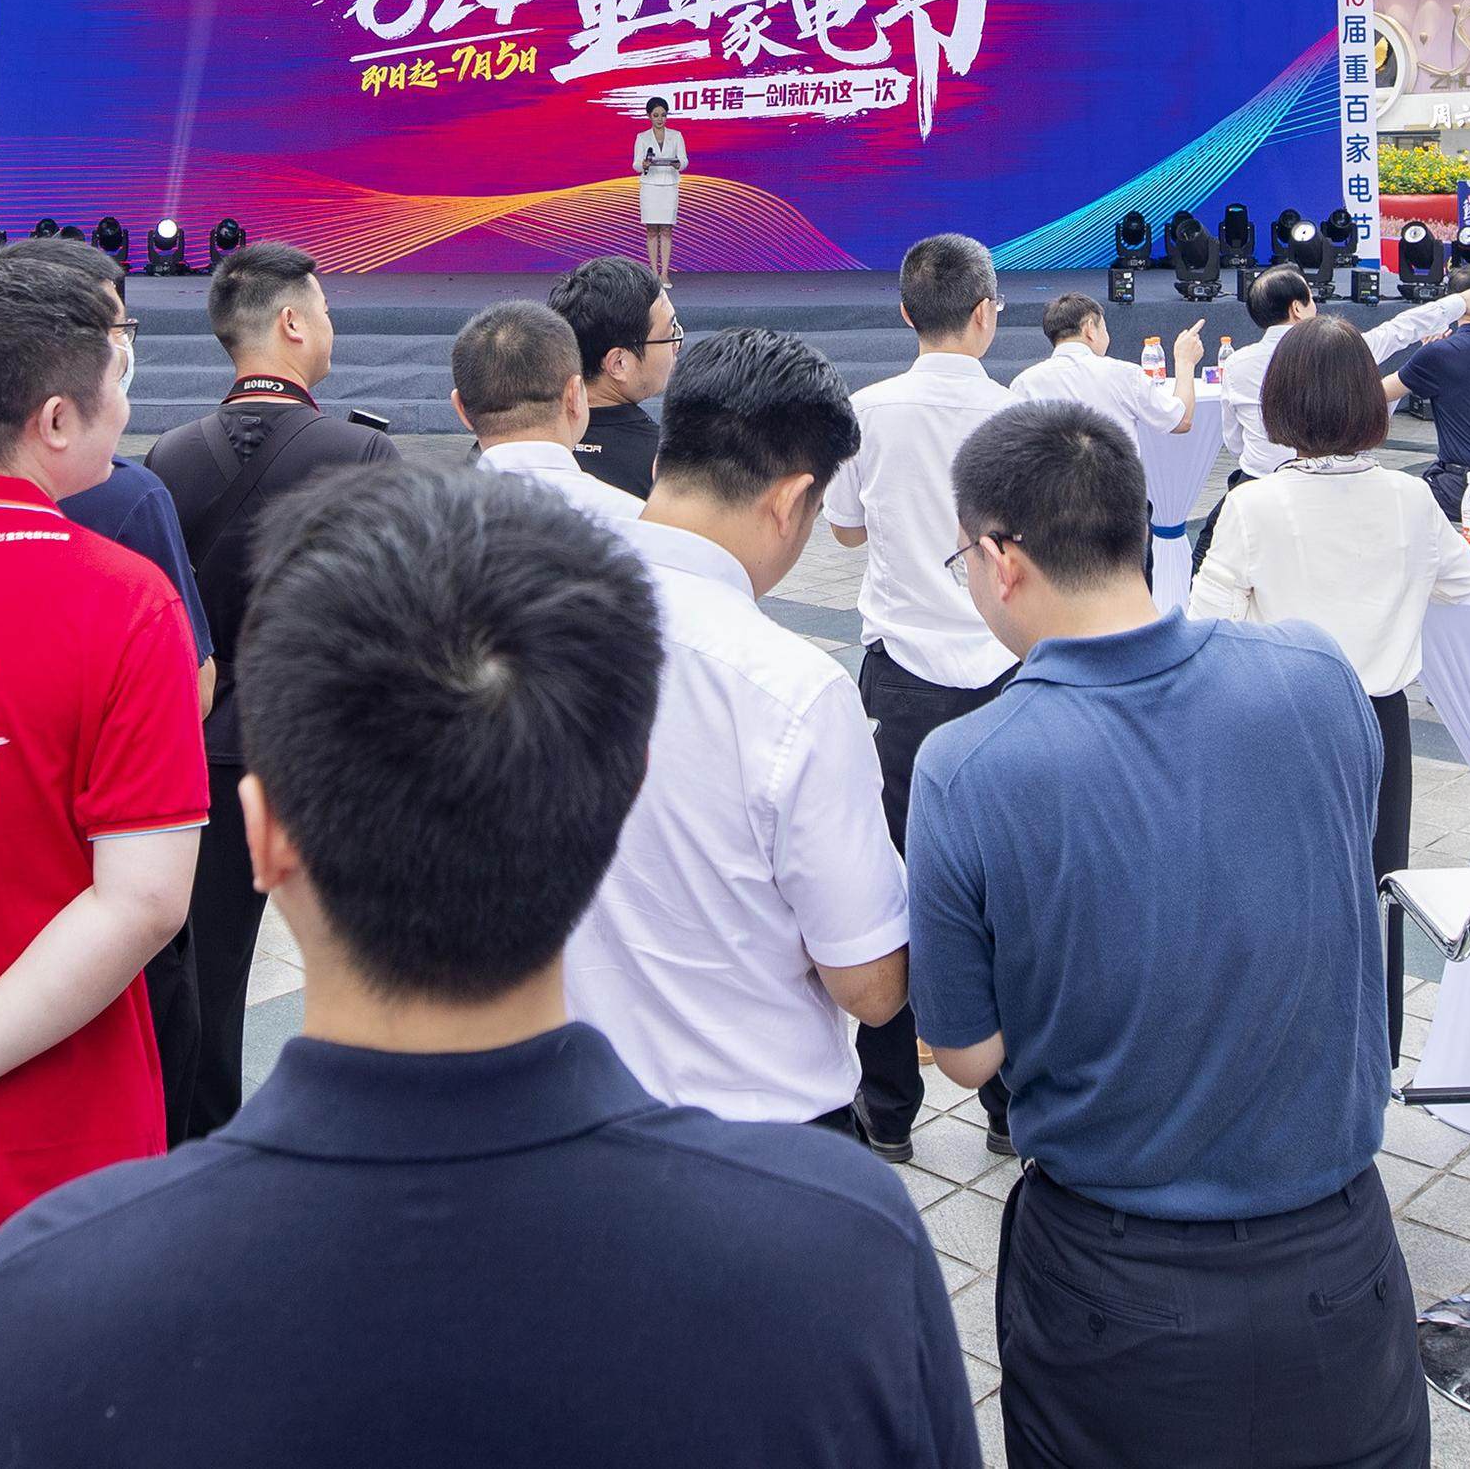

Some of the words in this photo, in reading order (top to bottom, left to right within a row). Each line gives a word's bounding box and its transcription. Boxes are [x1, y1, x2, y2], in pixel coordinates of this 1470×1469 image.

[673, 77, 898, 112] 10年磨一剑就为这一次
[243, 379, 284, 392] Canon
